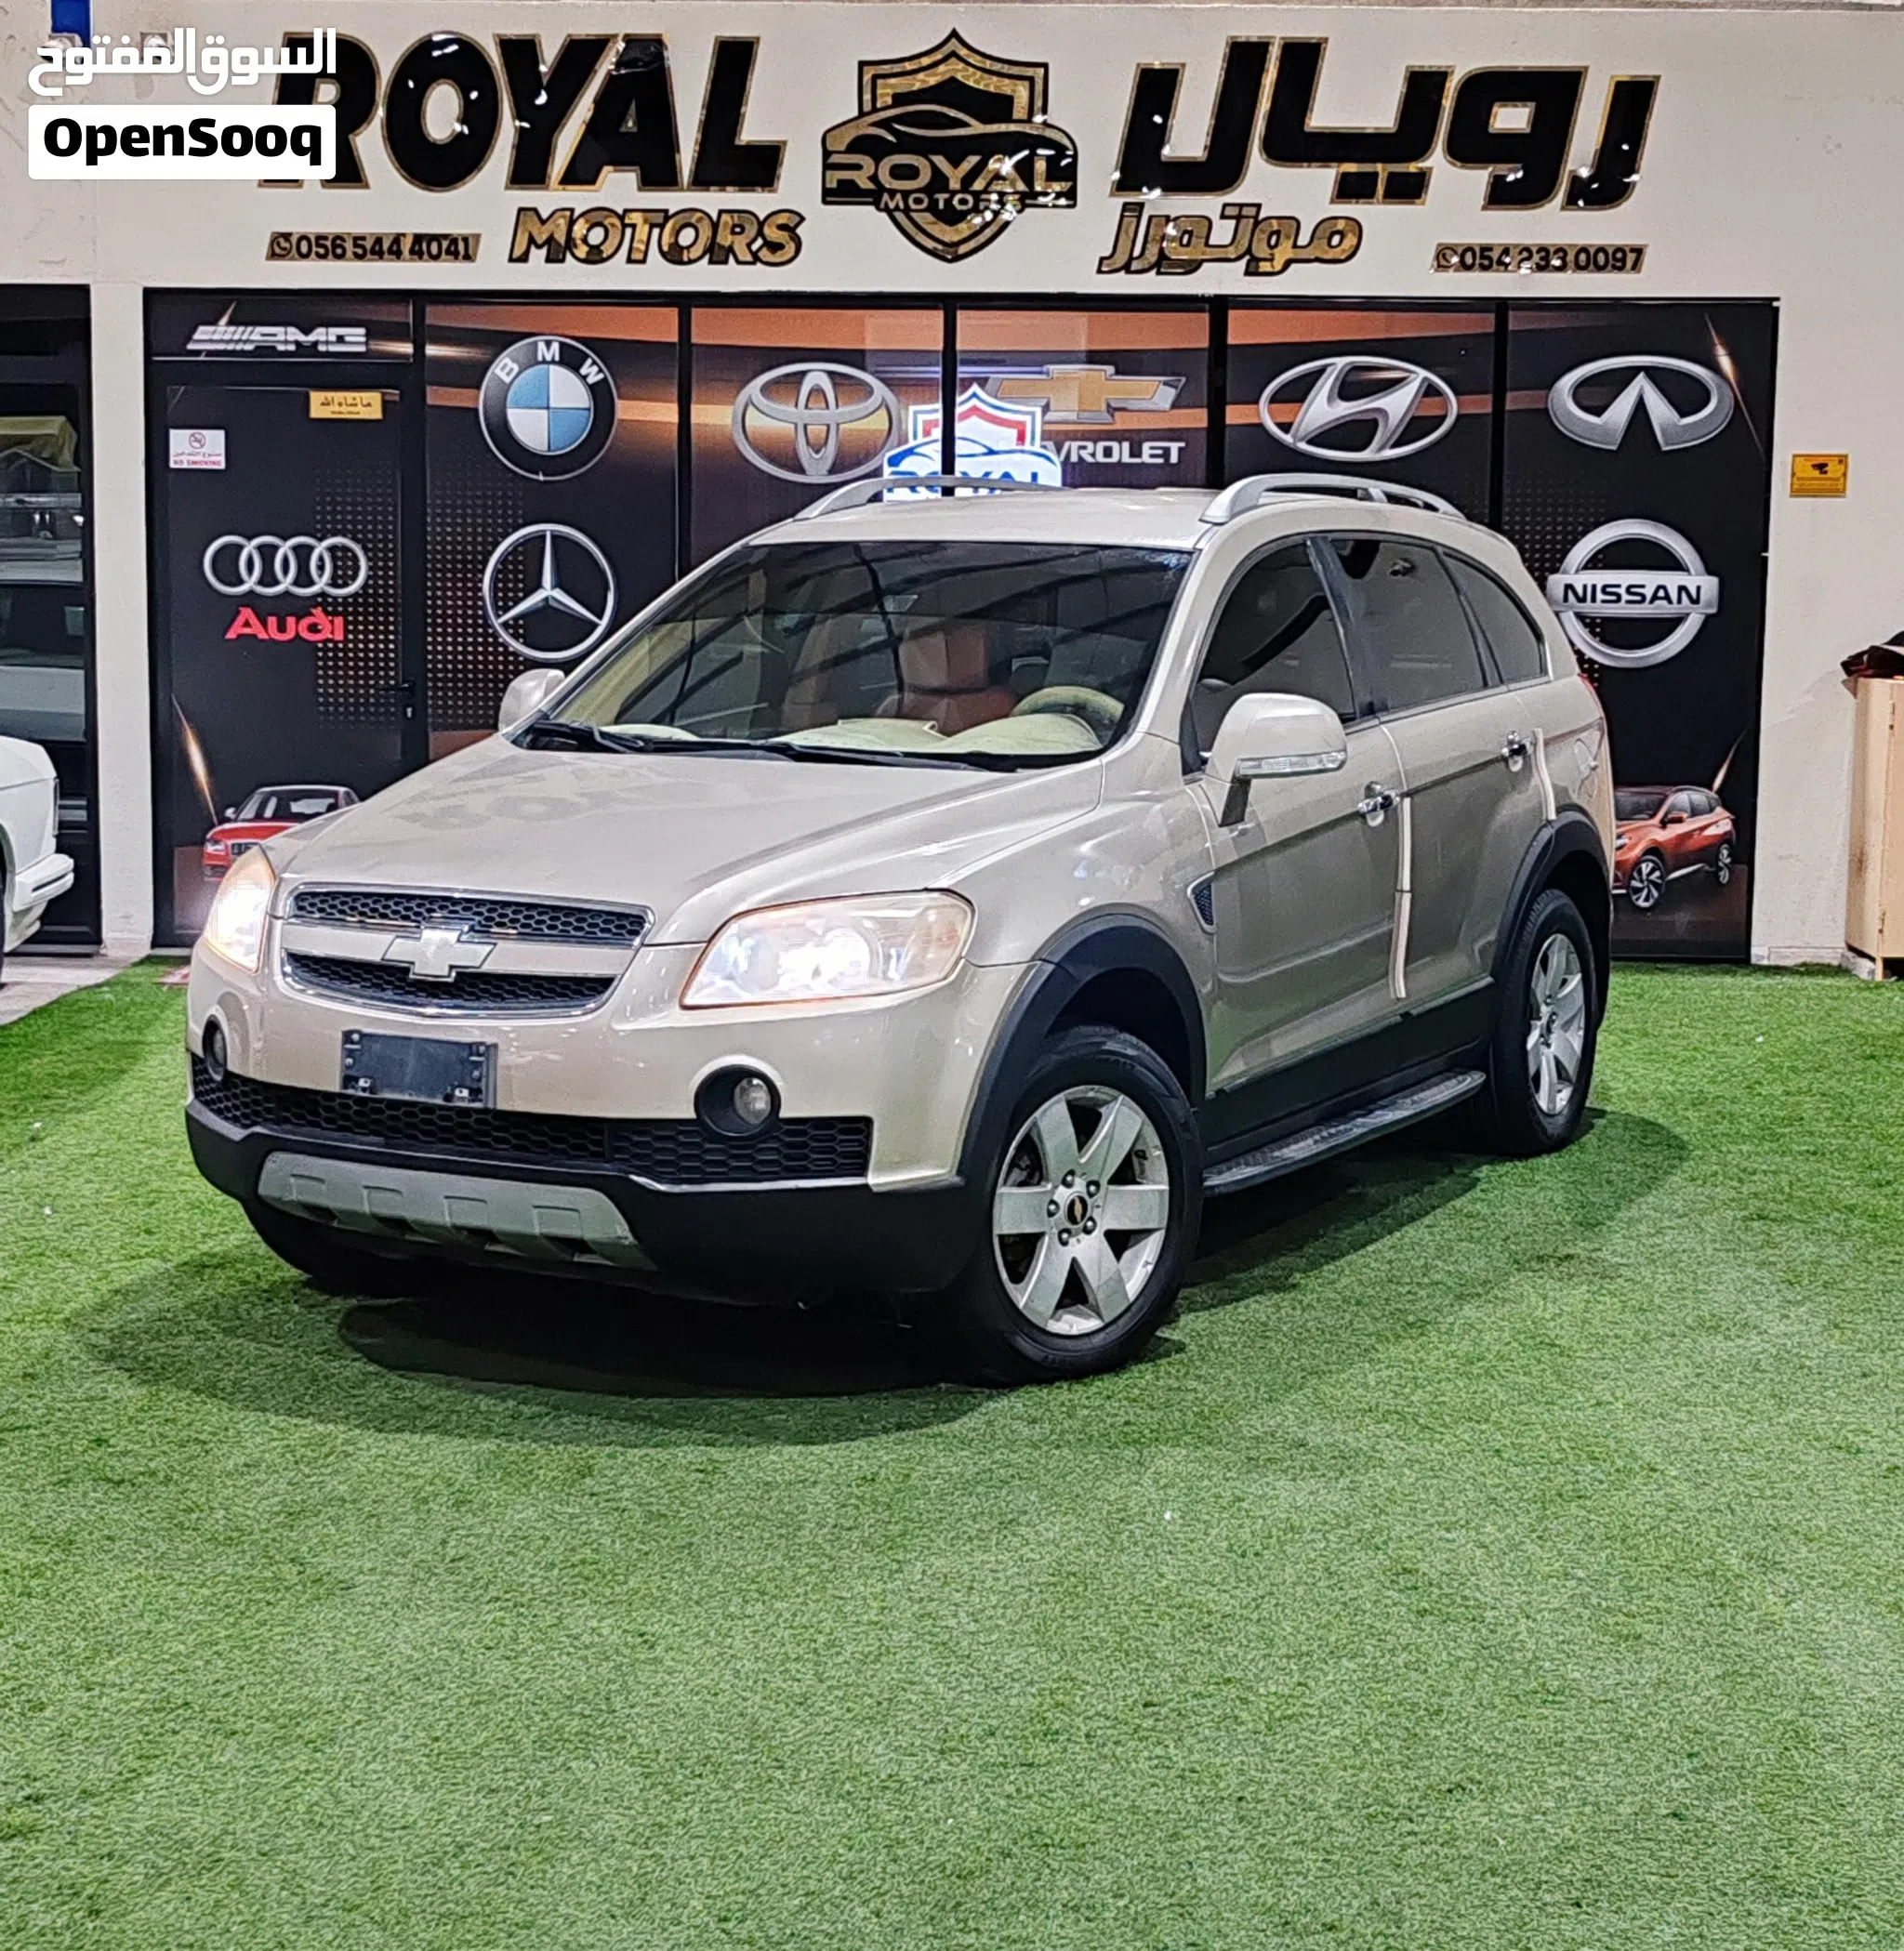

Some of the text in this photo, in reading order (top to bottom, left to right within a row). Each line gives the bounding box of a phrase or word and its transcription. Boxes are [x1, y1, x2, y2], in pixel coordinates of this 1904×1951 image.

[258, 32, 787, 192] ROYAL
[1109, 35, 1661, 211] رويال
[825, 153, 1074, 192] ROYAL
[879, 191, 1023, 212] MOTORS
[508, 206, 806, 268] MOTORS
[1096, 202, 1363, 276] موتورز
[242, 325, 366, 352] AMG
[494, 340, 605, 385] BMW
[1041, 441, 1186, 464] VROLET
[1562, 583, 1702, 606] NISSAN
[224, 606, 345, 641] Audi
